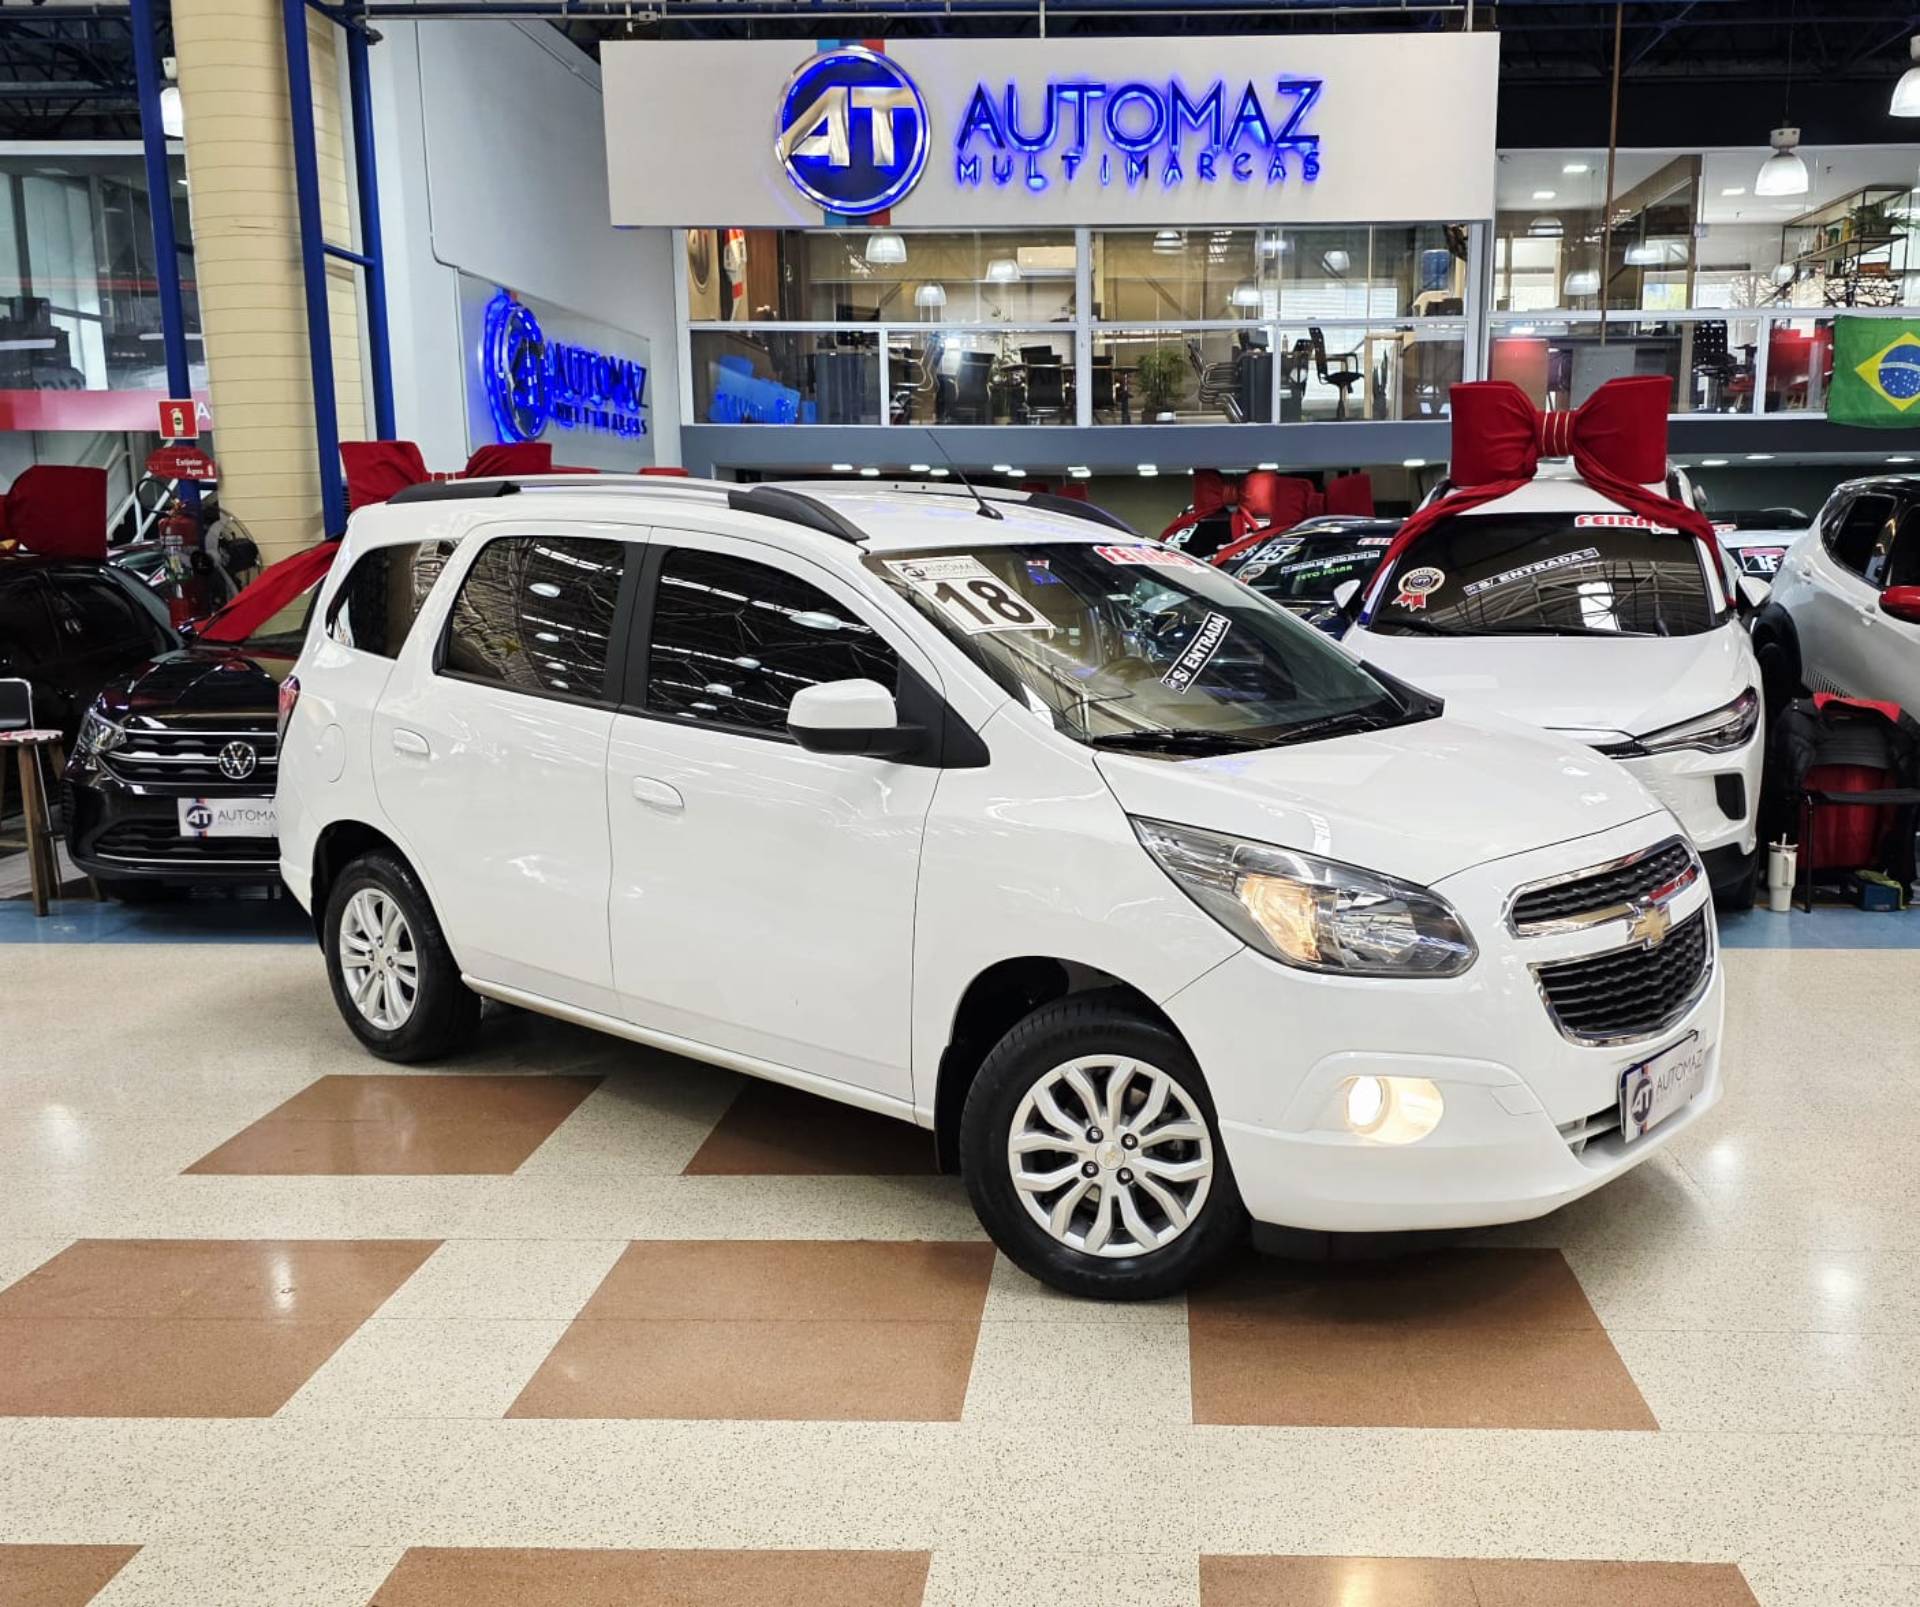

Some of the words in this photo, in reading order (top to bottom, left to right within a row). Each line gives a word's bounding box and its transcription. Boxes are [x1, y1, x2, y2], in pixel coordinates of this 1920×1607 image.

[777, 86, 918, 166] AT
[957, 80, 1322, 151] AUTOMAZ
[957, 152, 1320, 186] MULTIMARCAS
[549, 342, 648, 410] AUTOMAZ
[1499, 555, 1581, 579] ENTRADA
[934, 580, 1036, 625] 18
[1182, 615, 1226, 670] ENTRADA
[218, 809, 278, 822] AUTOMA
[1657, 1049, 1702, 1089] AUTOMAZ
